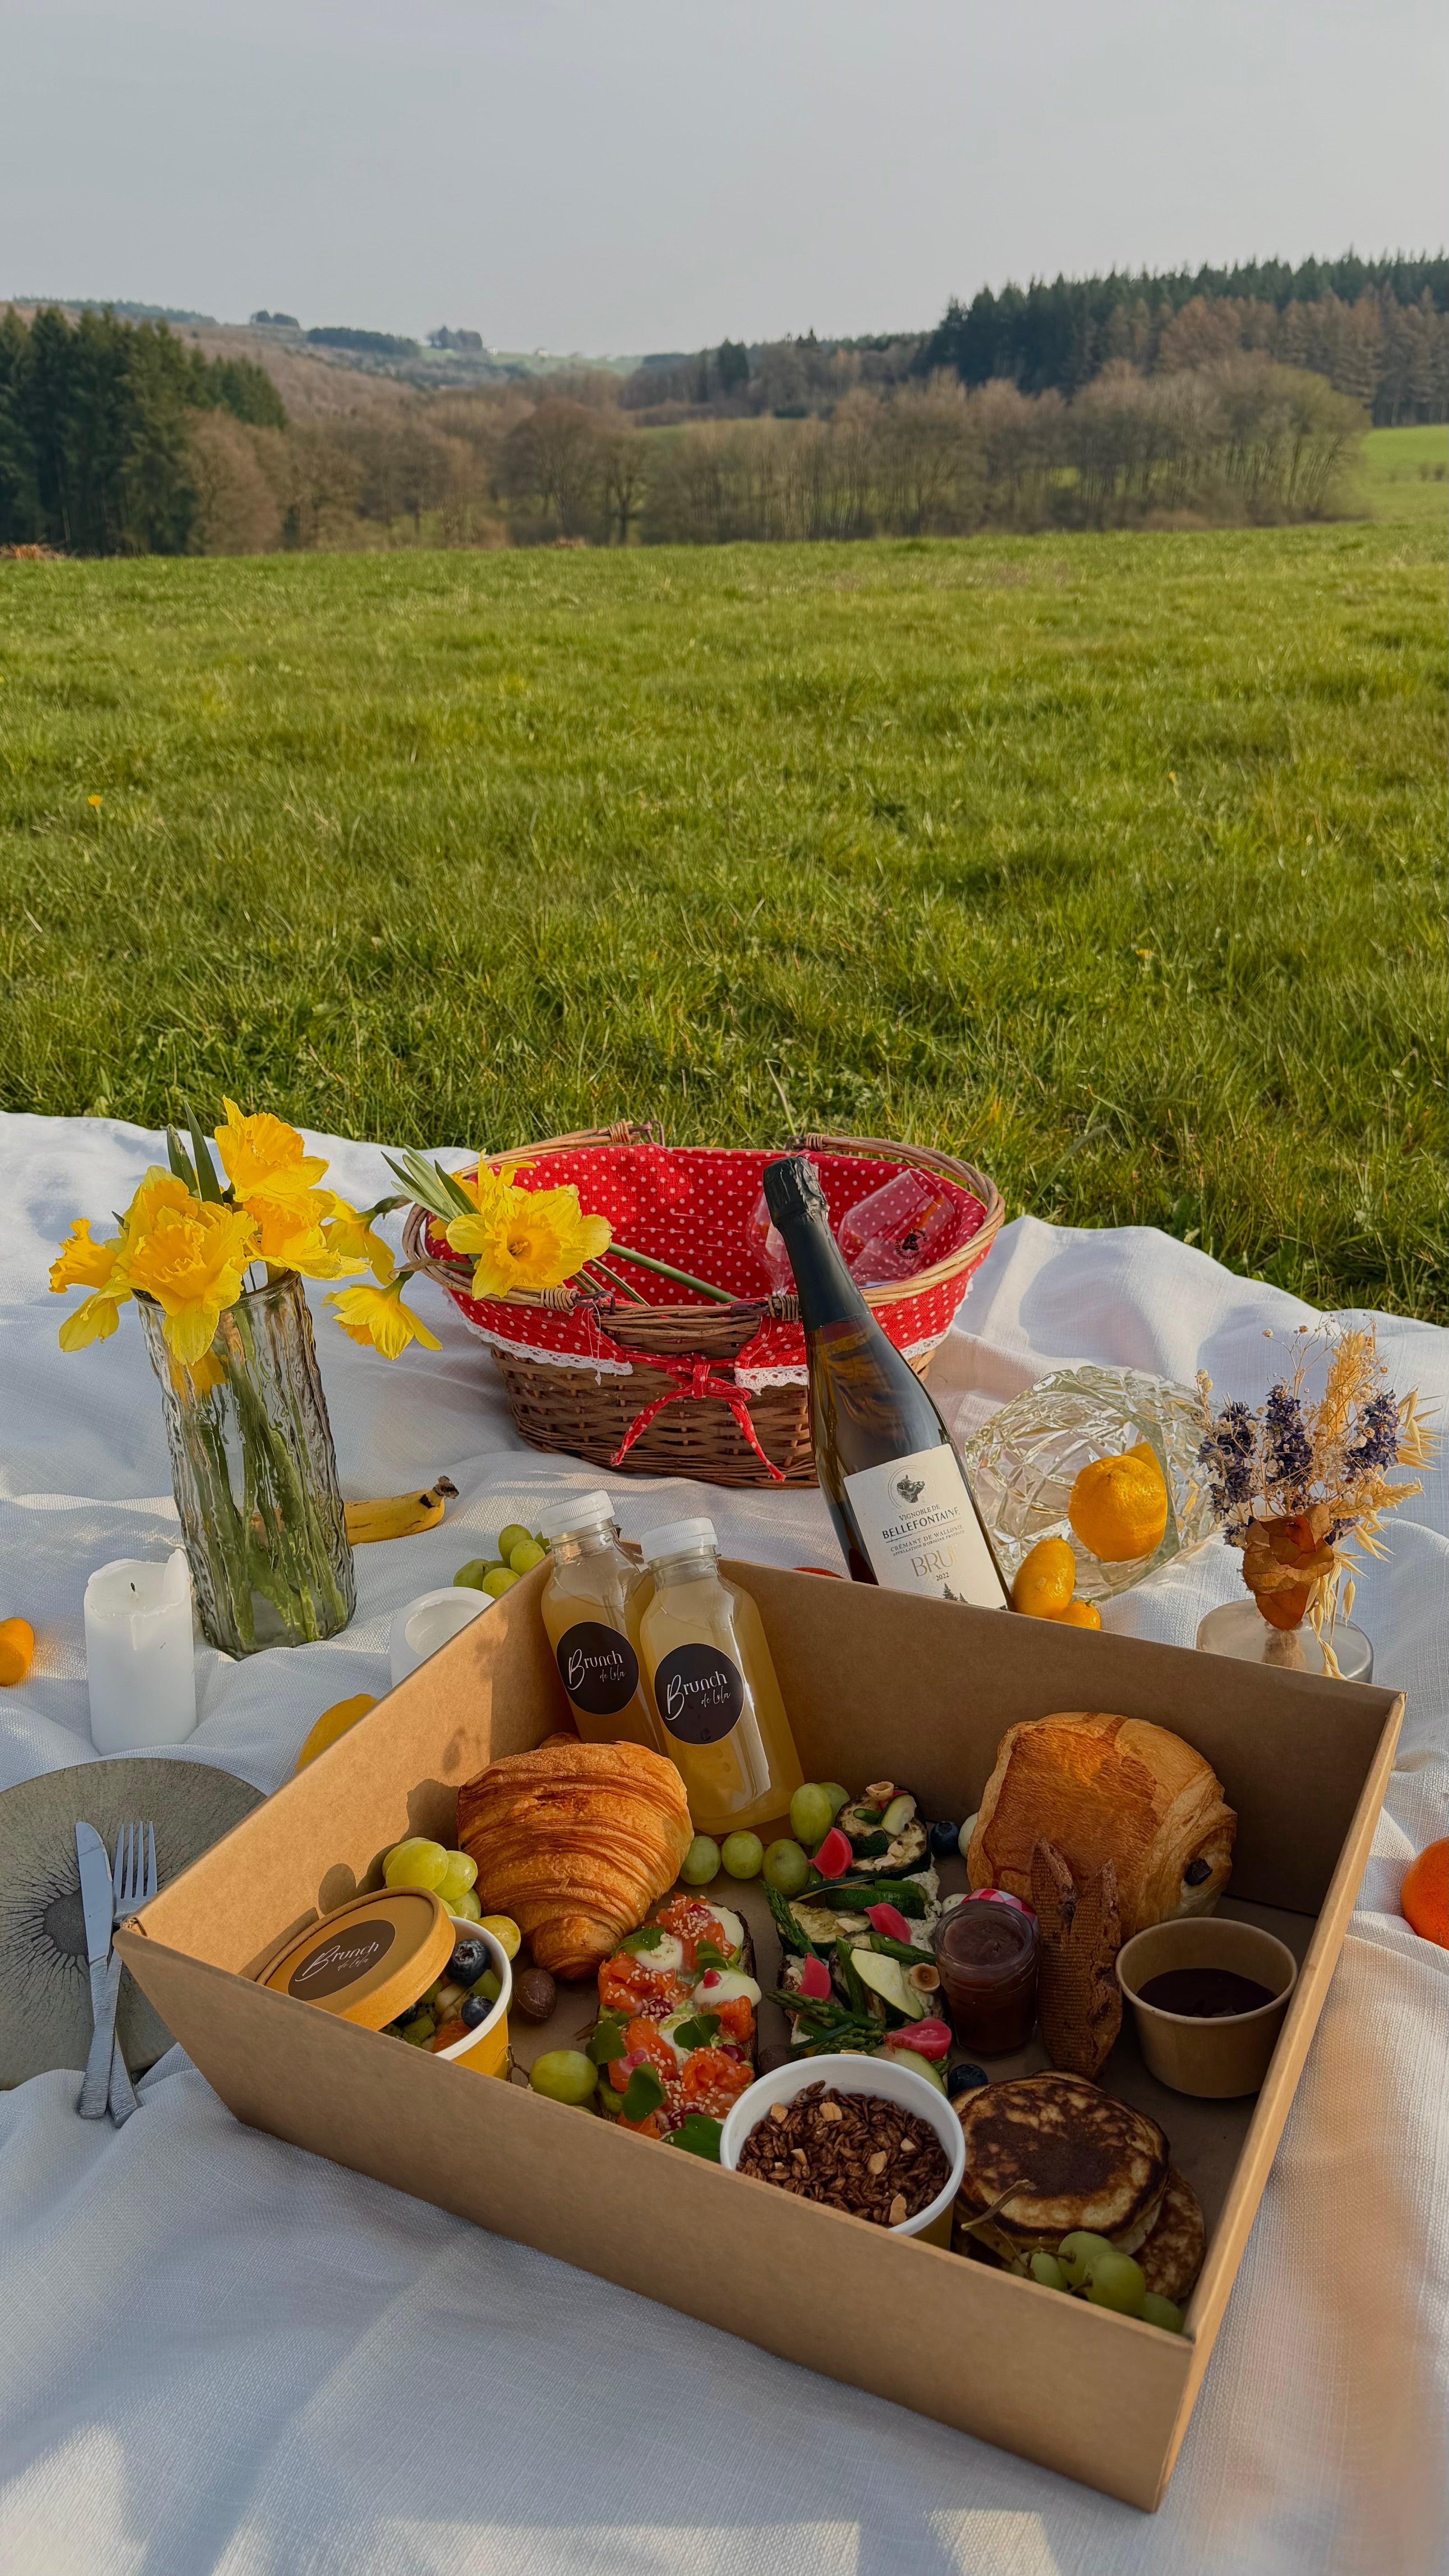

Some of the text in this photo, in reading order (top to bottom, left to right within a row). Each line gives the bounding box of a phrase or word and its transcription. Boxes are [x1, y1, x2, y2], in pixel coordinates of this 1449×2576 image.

[899, 1507, 931, 1521] VIGNOBLE
[882, 1507, 960, 1539] BELLEFONTAINE
[934, 1525, 963, 1537] WALLONIE
[935, 1572, 949, 1581] 2022
[567, 1649, 623, 1690] Brunch
[600, 1669, 608, 1682] de
[665, 1671, 727, 1720] Brunch
[701, 1693, 711, 1707] de
[295, 1941, 379, 1982] Brunch
